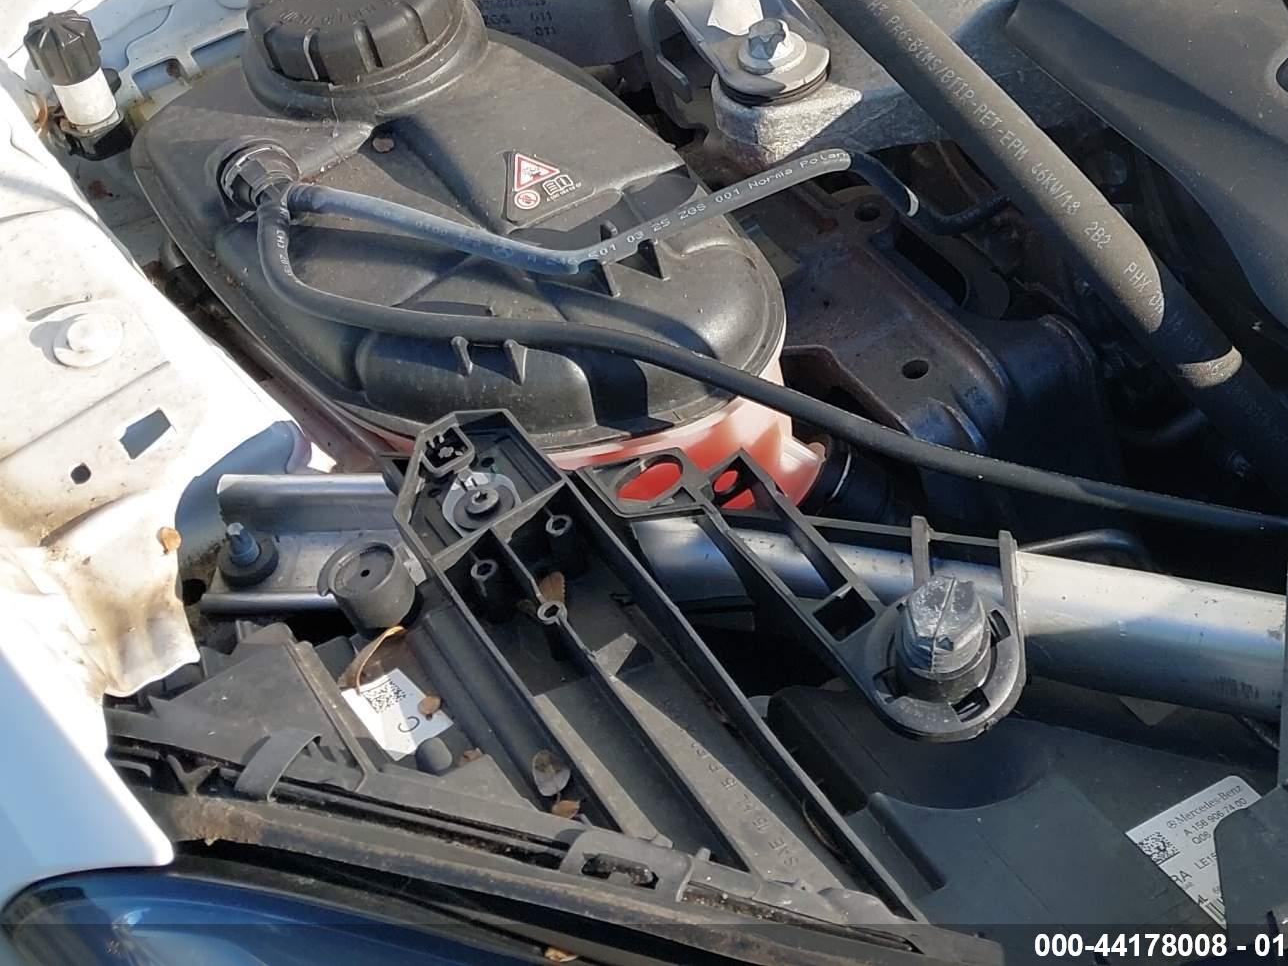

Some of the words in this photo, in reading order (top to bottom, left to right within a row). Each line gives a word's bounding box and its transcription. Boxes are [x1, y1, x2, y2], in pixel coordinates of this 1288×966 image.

[680, 202, 707, 220] ZGS
[714, 188, 741, 203] 001
[747, 168, 793, 189] Norma
[1123, 262, 1152, 293] PHX
[1174, 785, 1242, 825] Mercedes-Benz
